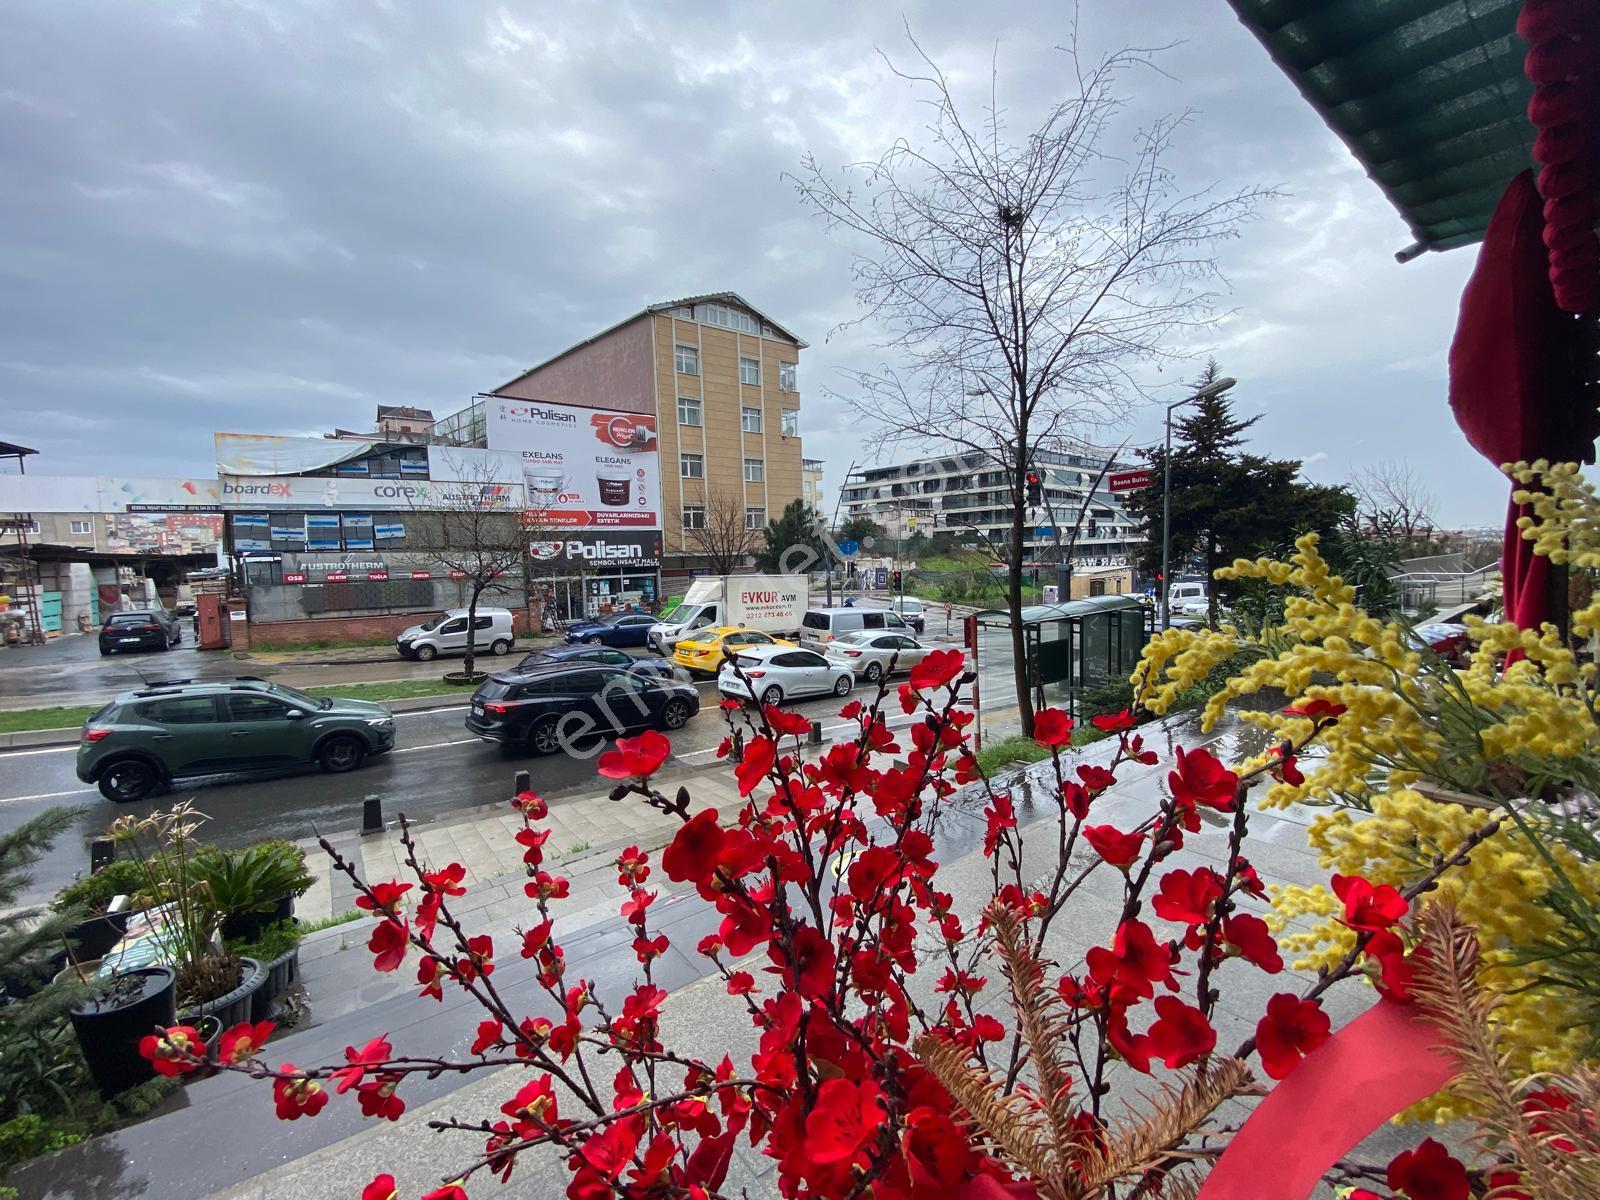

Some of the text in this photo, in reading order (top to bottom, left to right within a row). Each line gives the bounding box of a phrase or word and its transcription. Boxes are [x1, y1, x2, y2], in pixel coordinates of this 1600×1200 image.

[530, 407, 577, 422] Polisan
[536, 420, 577, 428] COSMETICS
[522, 451, 564, 460] EXELANS
[595, 456, 632, 465] ELEGANS
[566, 540, 643, 560] Polisan
[300, 562, 384, 571] AUSTROTHERM
[741, 591, 797, 604] EVKUR AVM
[746, 612, 762, 620] 0212
